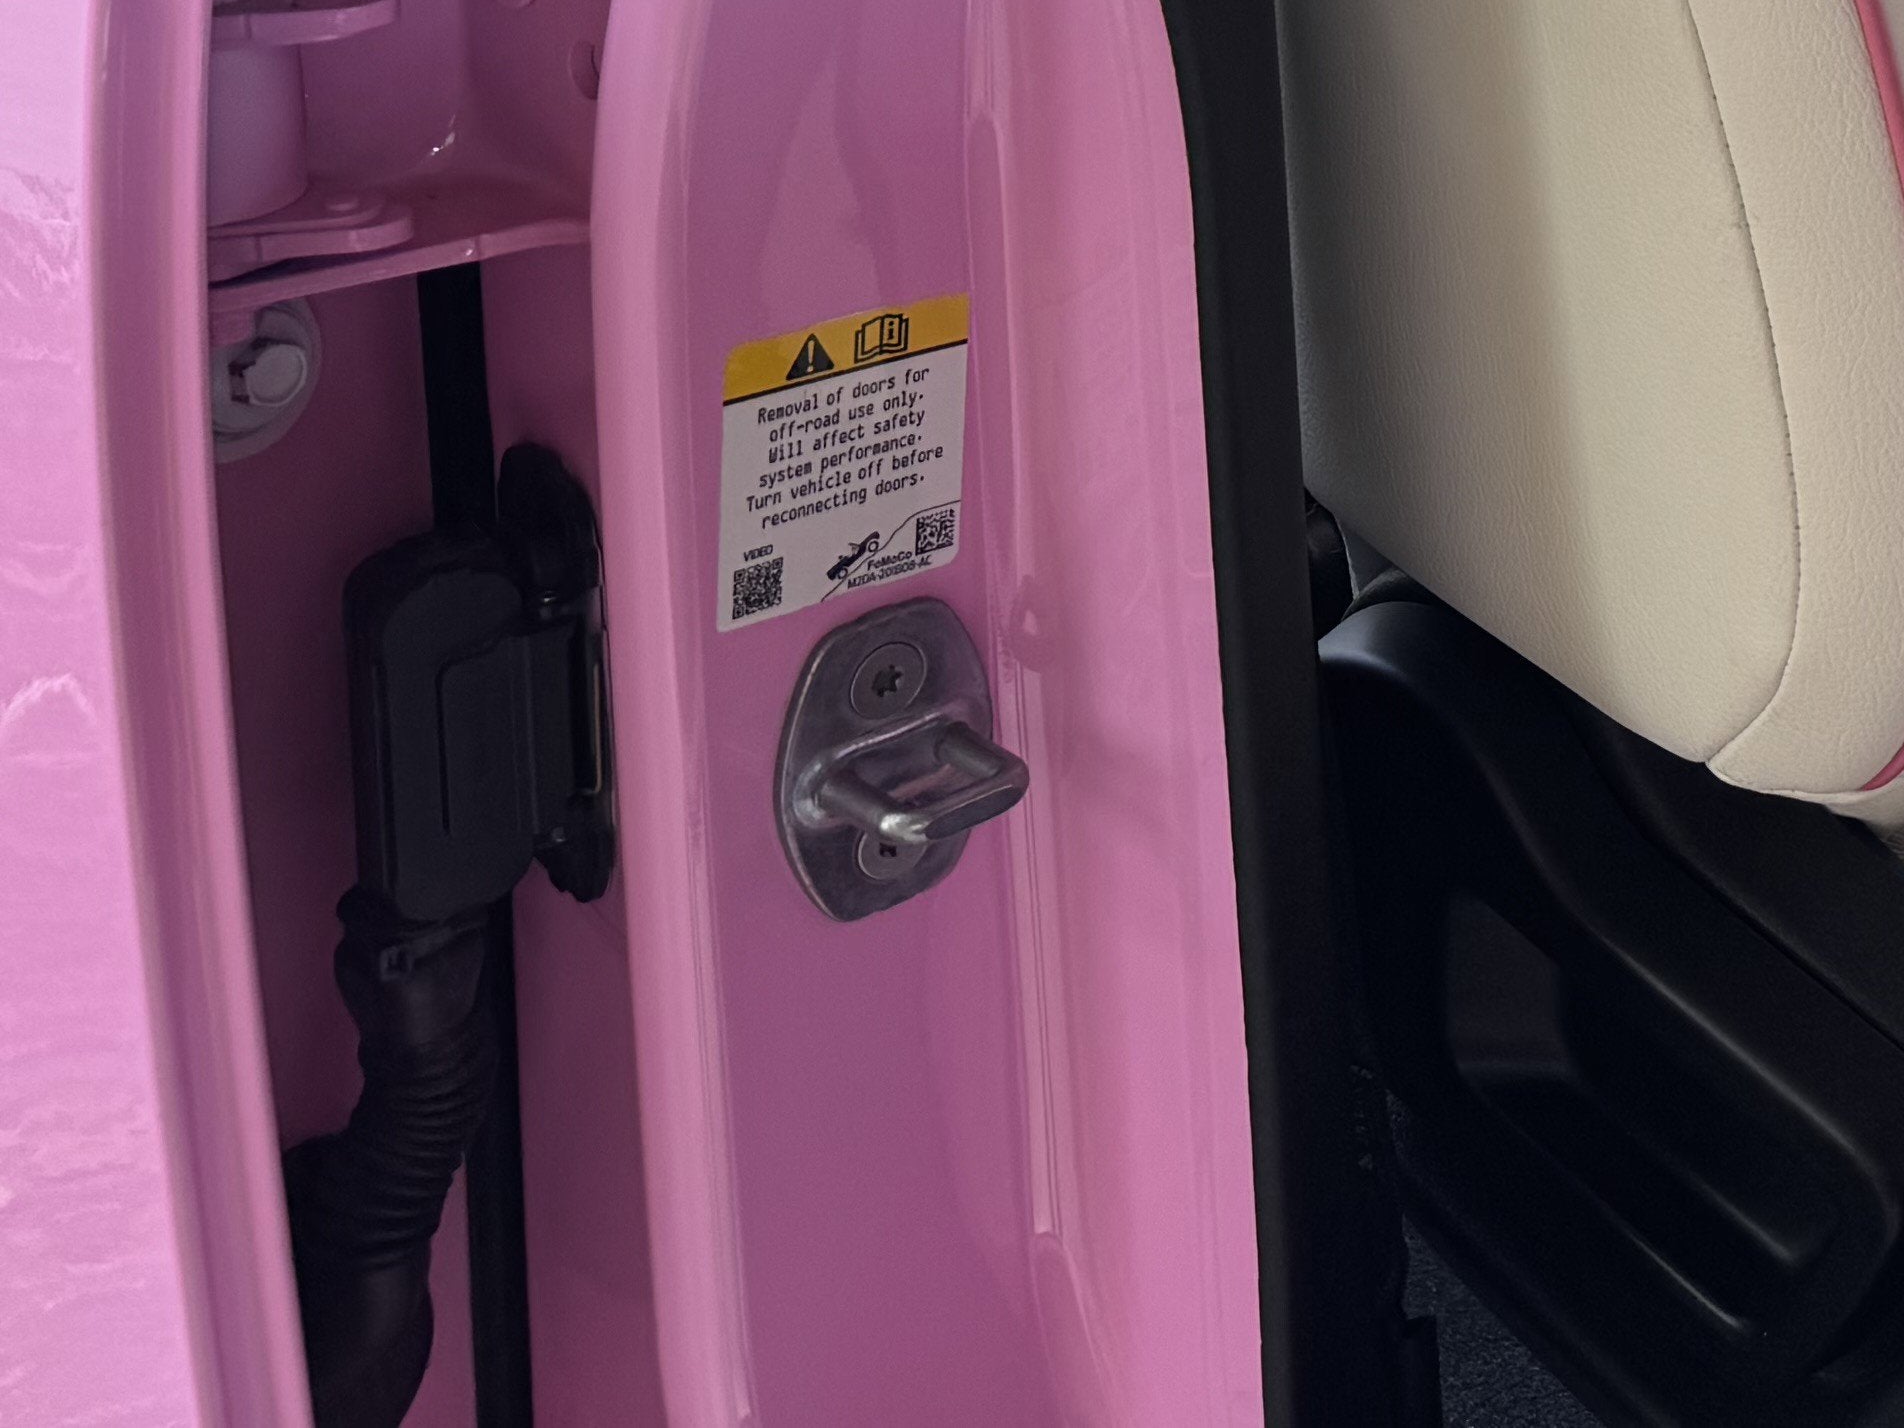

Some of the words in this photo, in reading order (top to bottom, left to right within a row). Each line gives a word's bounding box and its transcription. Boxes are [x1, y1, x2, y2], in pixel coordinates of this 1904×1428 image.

[757, 393, 818, 424] Removal
[826, 386, 844, 406] of
[852, 376, 895, 399] doors
[905, 368, 930, 385] for
[769, 409, 840, 442] off-road
[848, 403, 874, 421] use
[883, 391, 924, 412] only.
[758, 461, 812, 489] system
[820, 433, 922, 474] performance.
[768, 440, 803, 464] Will
[813, 424, 865, 451] affect
[873, 409, 925, 435] safety
[746, 491, 782, 513] Turn
[790, 470, 851, 499] vehicle
[858, 458, 884, 480] off
[892, 446, 944, 471] before
[761, 487, 867, 530] reconnecting
[875, 472, 925, 496] doors.
[743, 544, 774, 562] VIDEO
